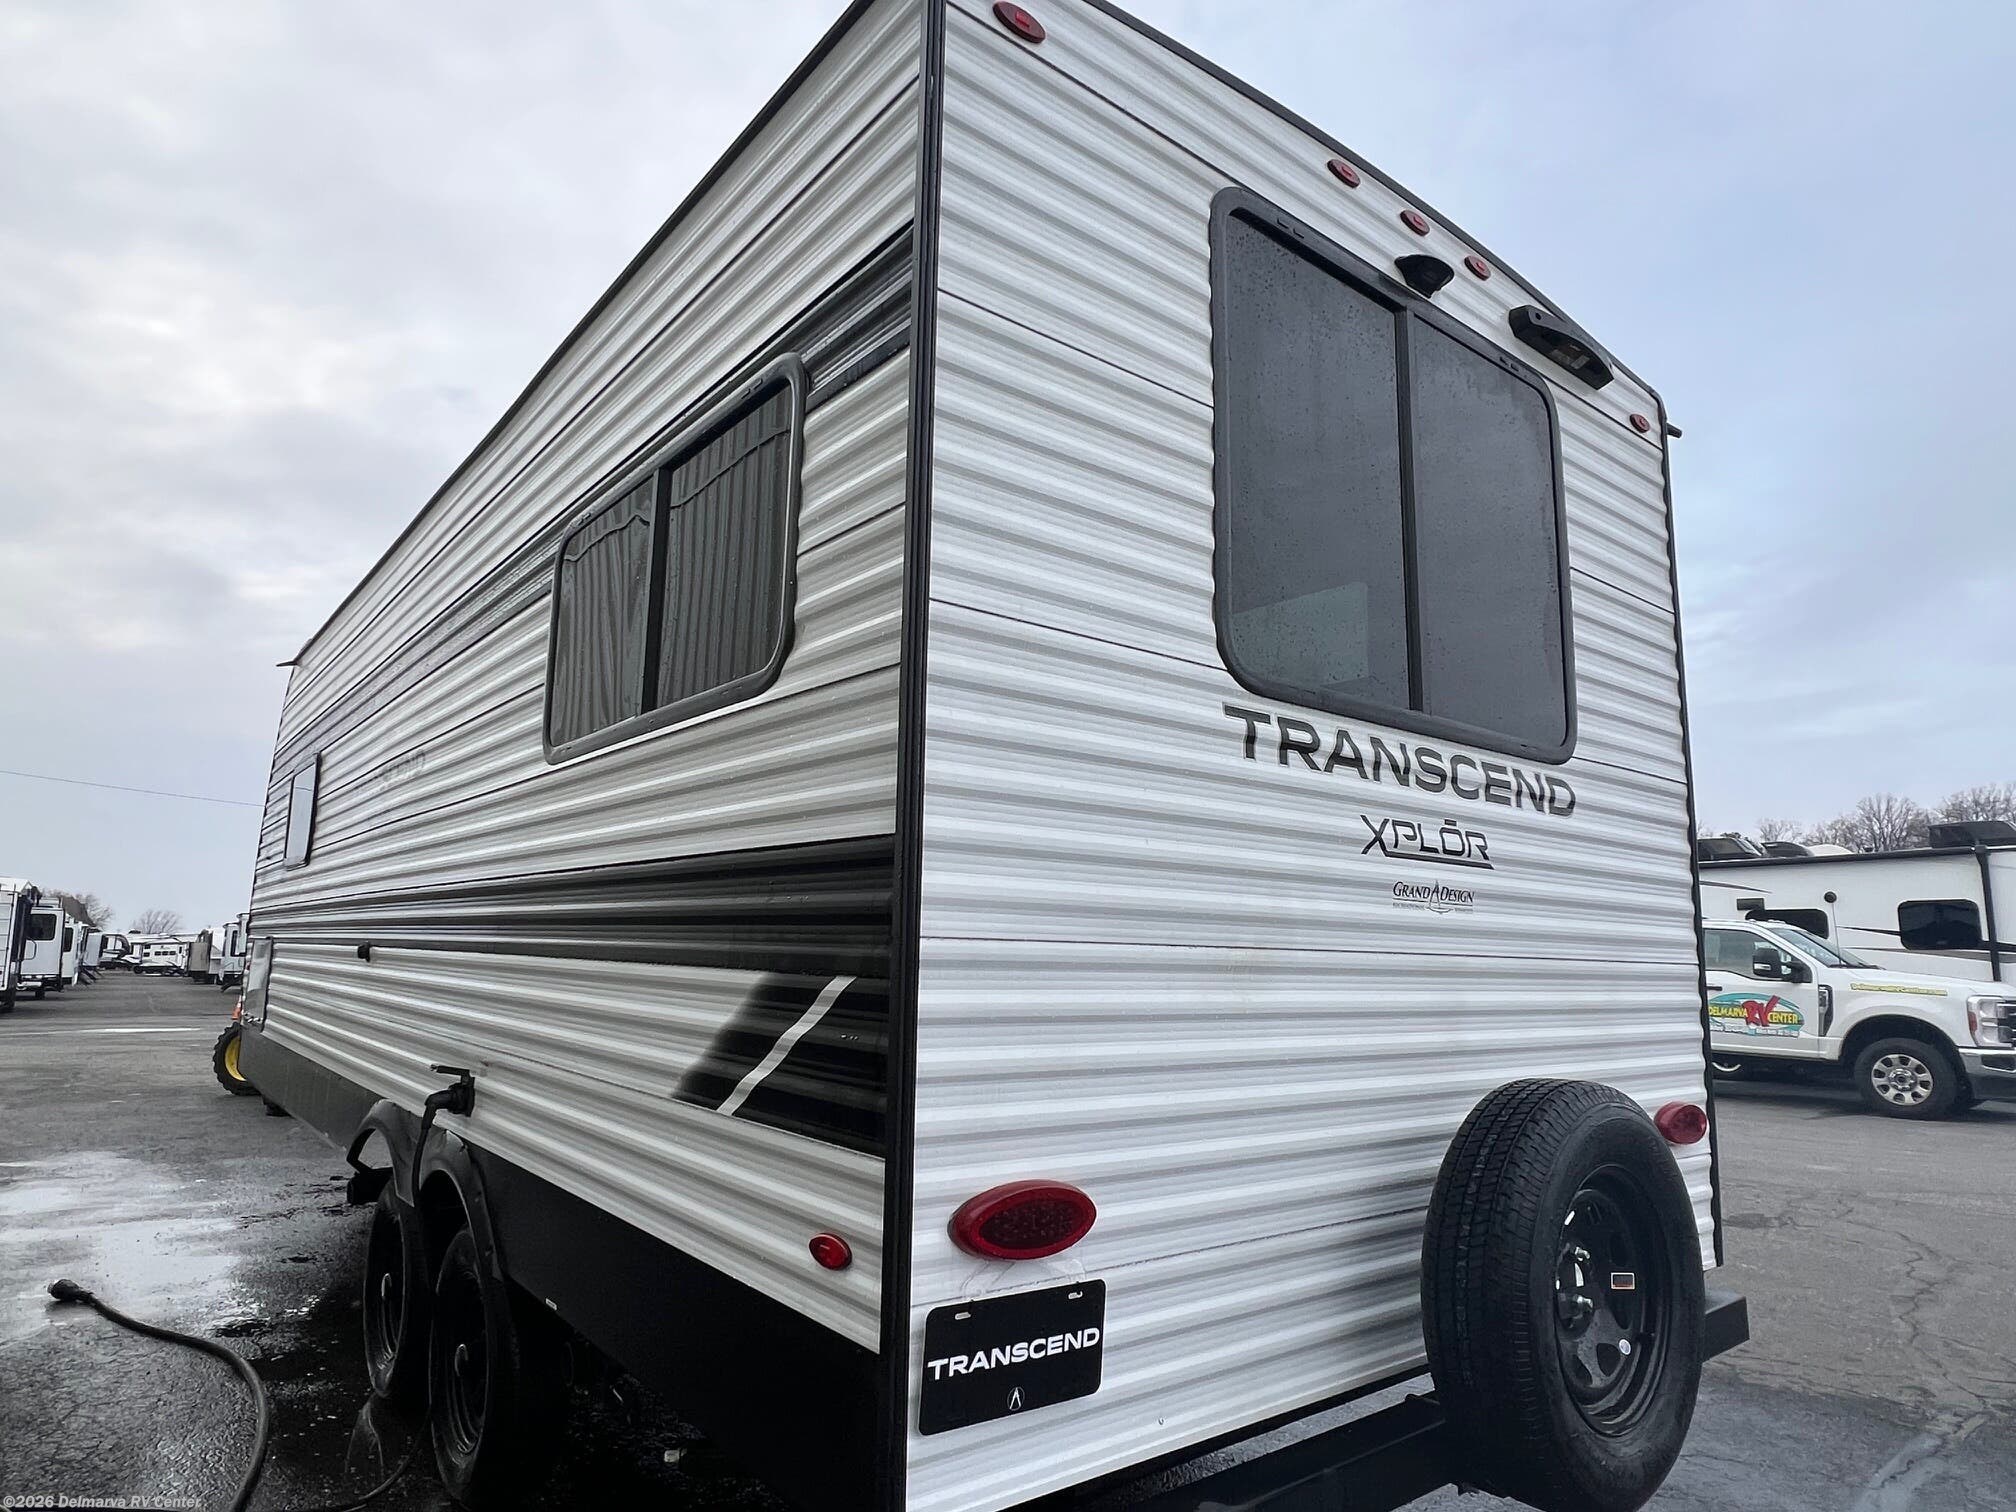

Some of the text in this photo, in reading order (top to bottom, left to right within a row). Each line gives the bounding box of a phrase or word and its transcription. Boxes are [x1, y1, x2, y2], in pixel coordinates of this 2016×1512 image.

[1222, 702, 1577, 817] TRANSCEND
[1393, 881, 1475, 903] GRAND DESIGN
[1708, 995, 1799, 1027] DELMARVA RV CENTER
[927, 1327, 1100, 1381] TRANSCEND
